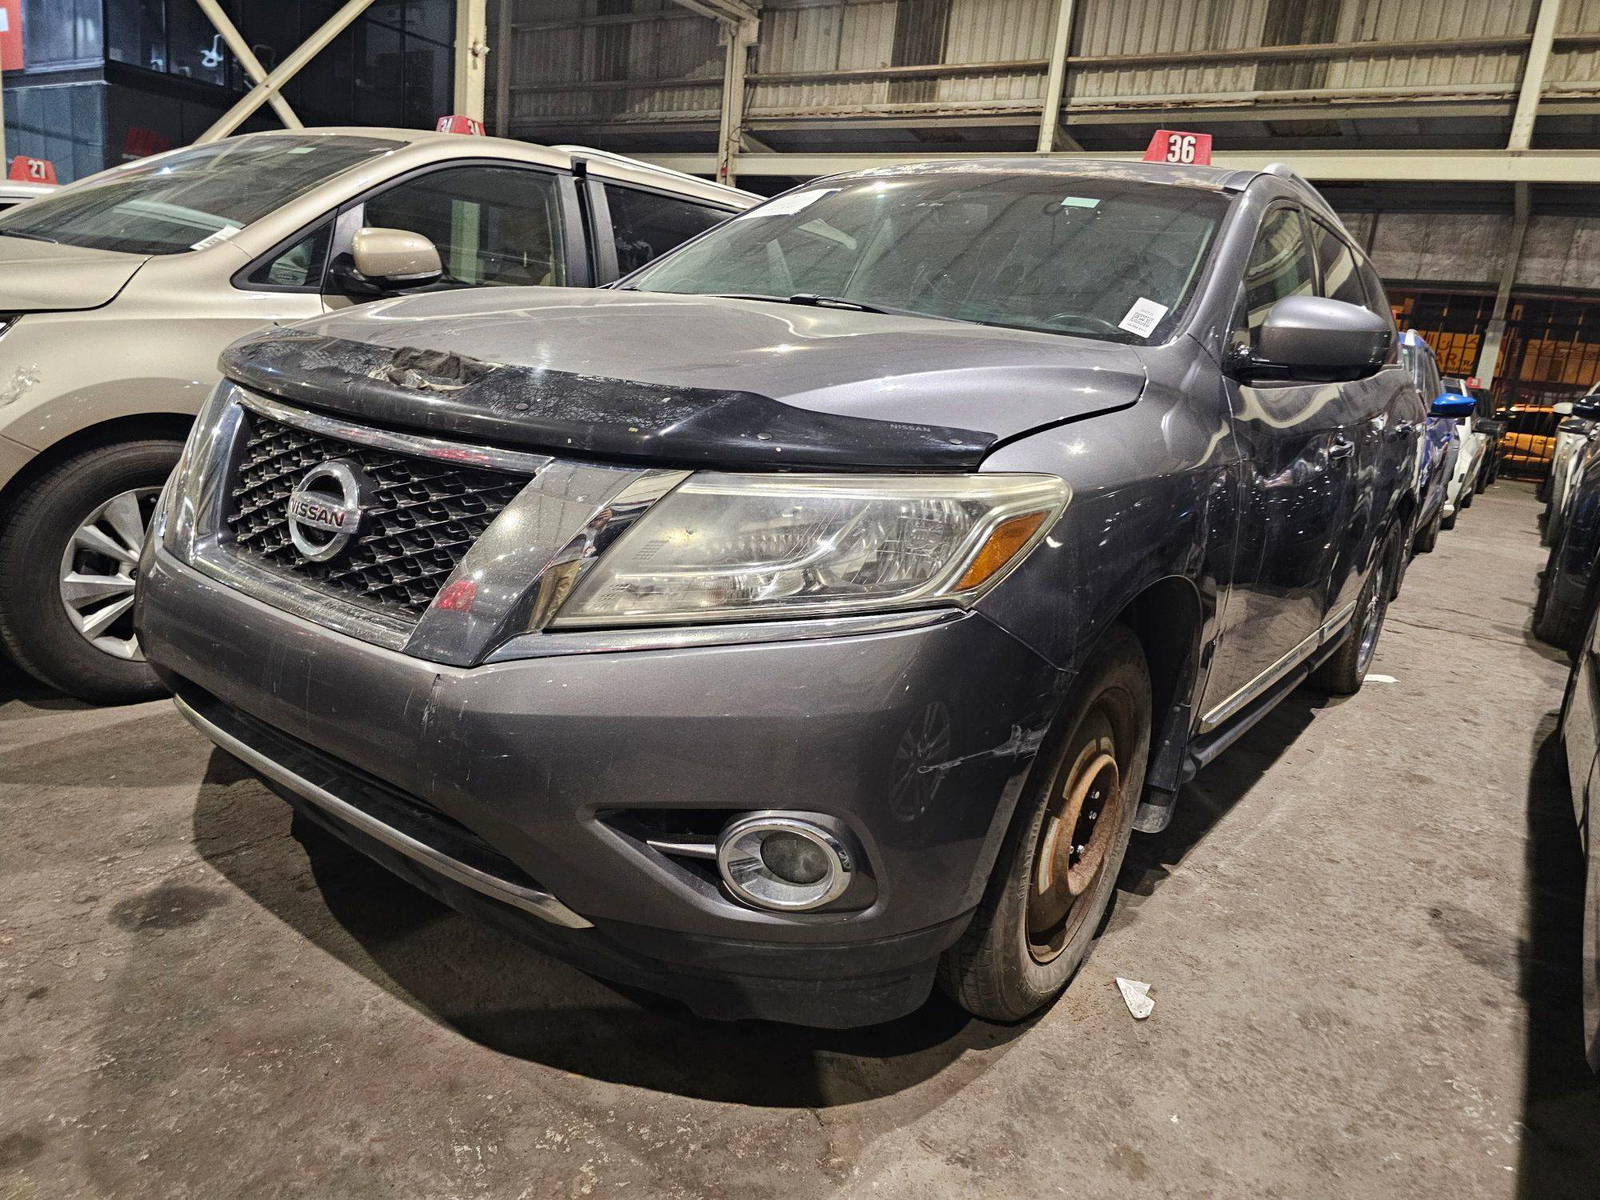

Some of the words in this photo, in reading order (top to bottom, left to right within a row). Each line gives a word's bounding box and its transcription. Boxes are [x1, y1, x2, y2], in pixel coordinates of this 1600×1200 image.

[1167, 134, 1196, 164] 36
[28, 159, 46, 179] 27
[890, 423, 931, 433] NISSAN
[291, 498, 345, 527] NISSAN
